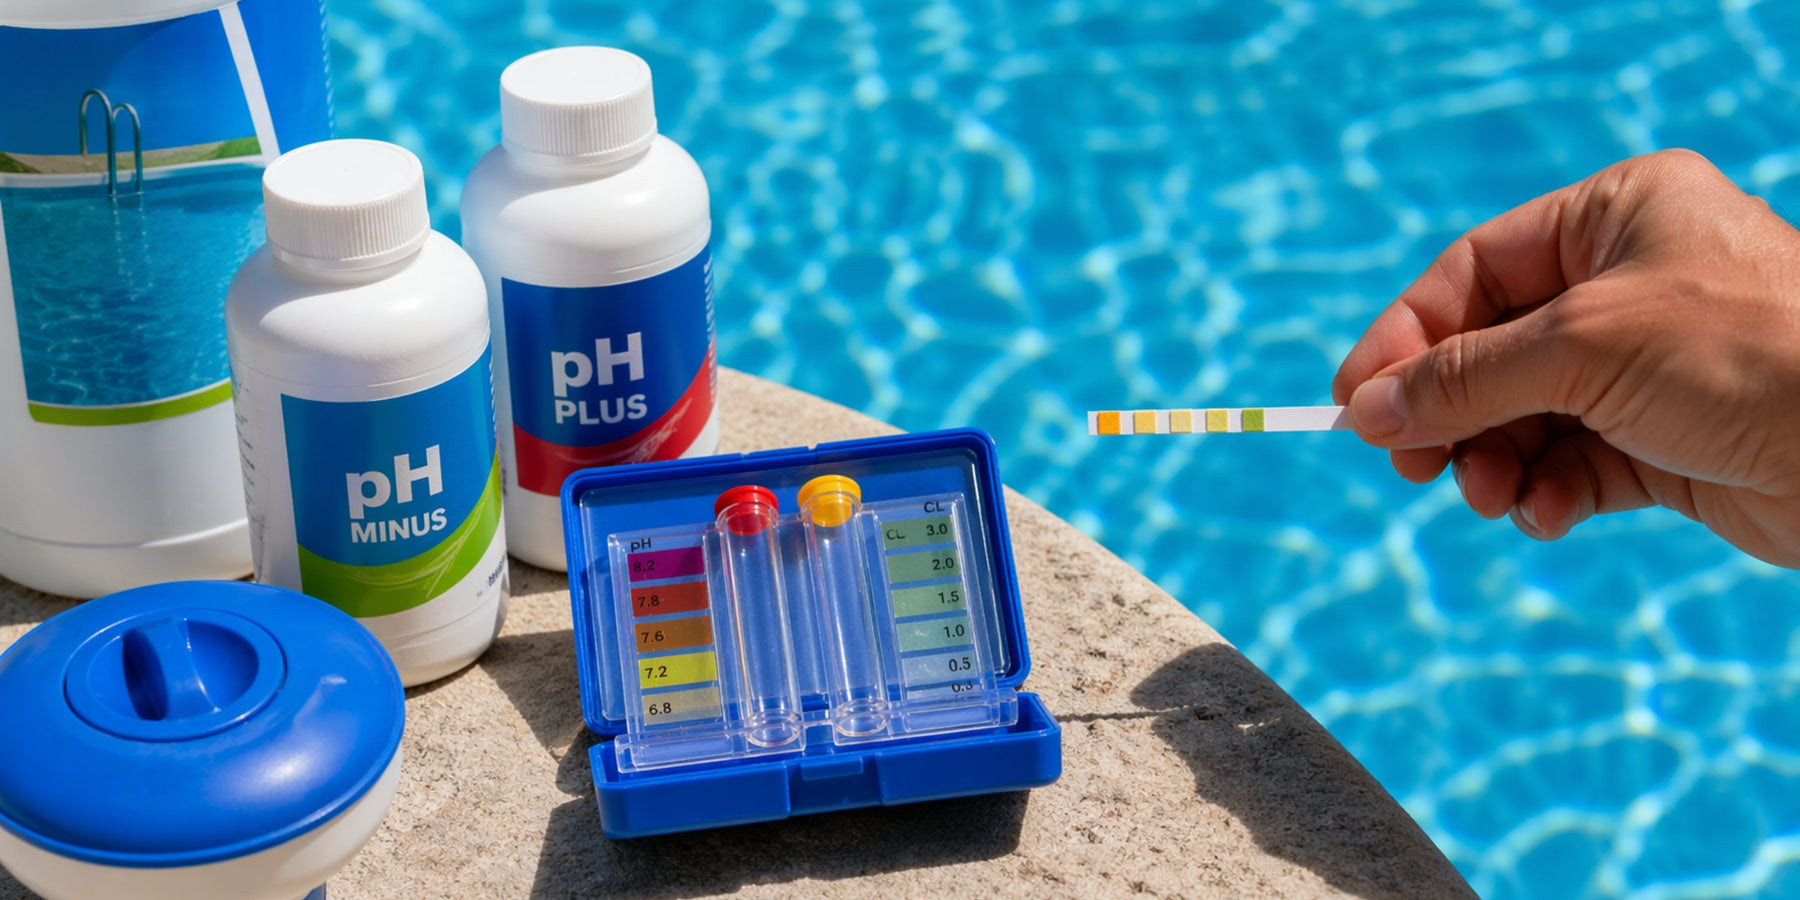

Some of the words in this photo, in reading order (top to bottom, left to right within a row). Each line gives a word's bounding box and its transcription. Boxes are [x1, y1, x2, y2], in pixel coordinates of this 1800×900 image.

[551, 331, 645, 397] pH
[554, 393, 648, 425] PLUS
[345, 444, 443, 520] pH
[923, 500, 945, 513] CL
[350, 507, 447, 544] MINUS
[886, 528, 906, 540] CL
[925, 523, 948, 536] 3.0
[630, 537, 652, 553] pH
[633, 560, 656, 573] 8.2
[931, 557, 955, 570] 2.0
[637, 595, 660, 608] 7.8
[937, 590, 960, 604] 1.5
[641, 630, 665, 644] 7.6
[943, 624, 965, 638] 1.0
[948, 657, 971, 672] 0.5
[644, 666, 668, 679] 7.2
[649, 702, 672, 715] 6.8
